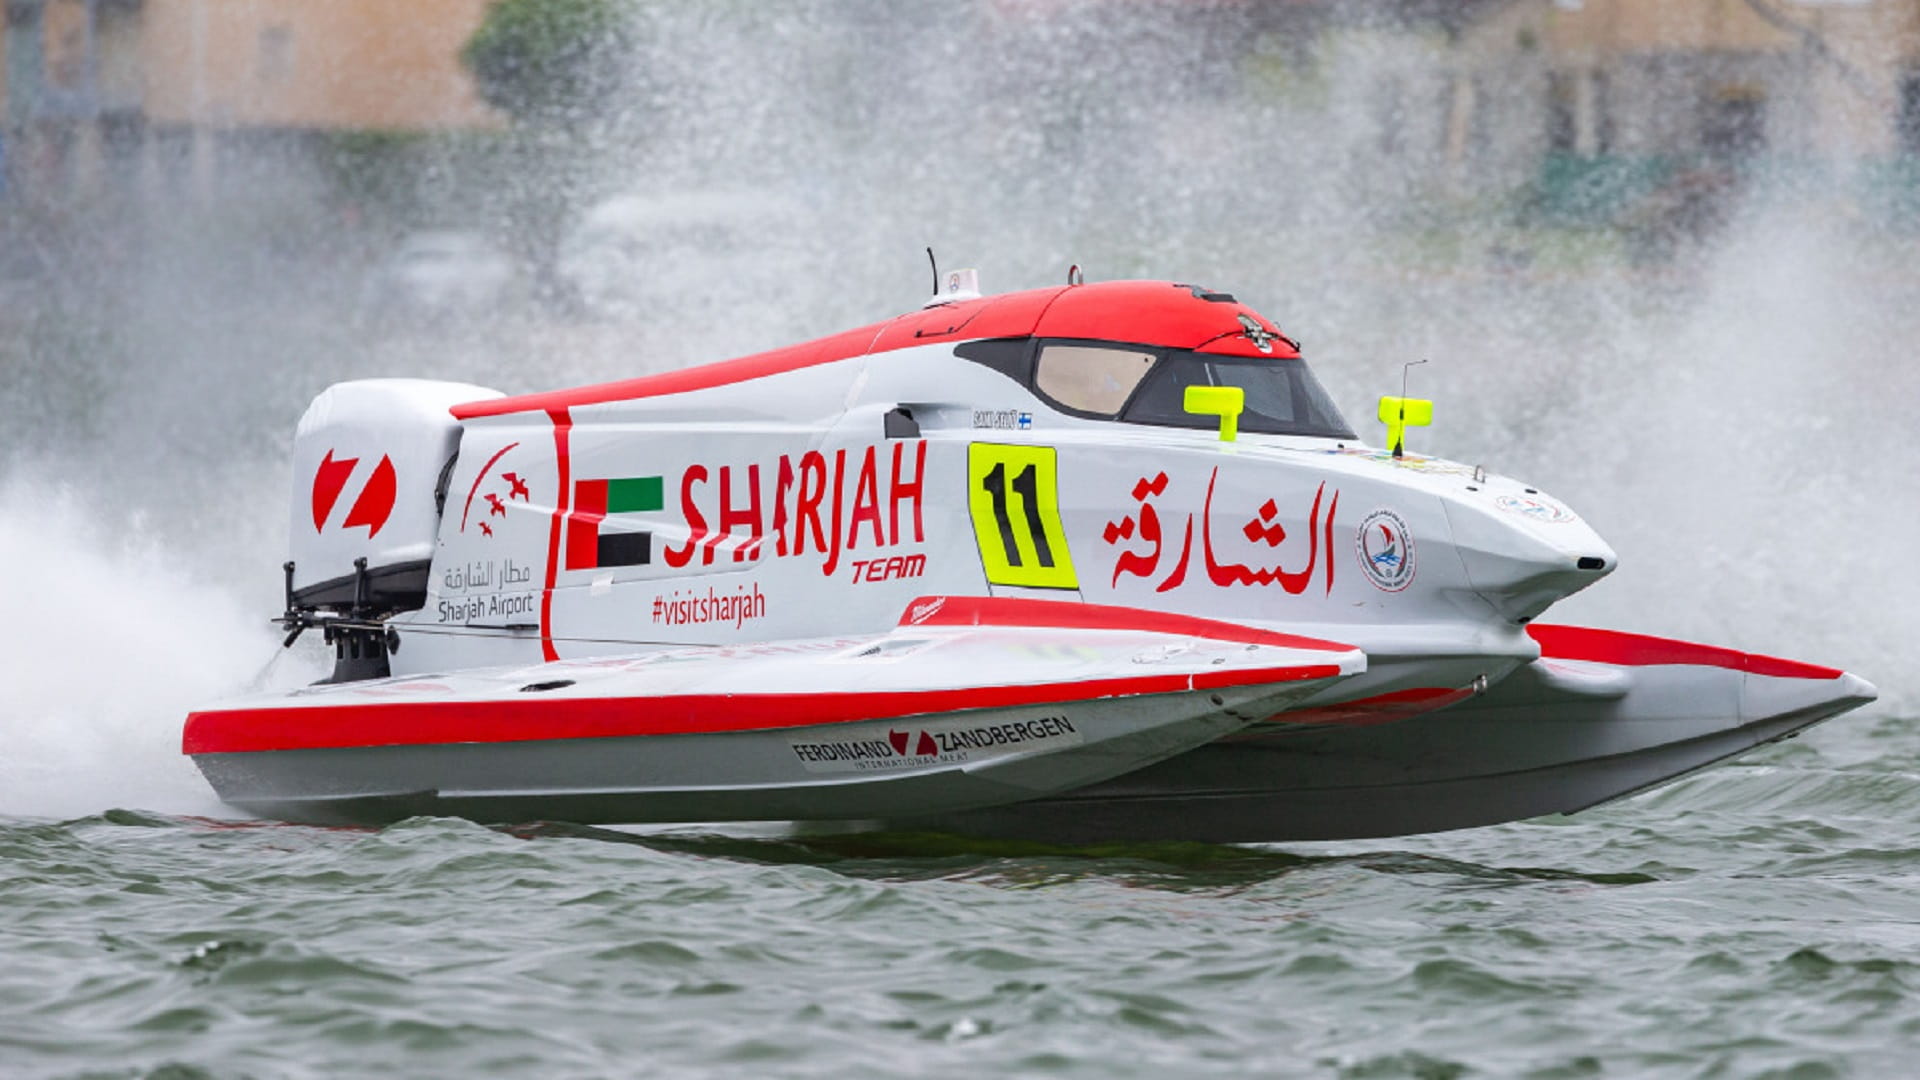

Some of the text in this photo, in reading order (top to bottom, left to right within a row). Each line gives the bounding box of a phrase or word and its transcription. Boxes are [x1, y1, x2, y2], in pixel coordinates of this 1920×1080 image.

[663, 439, 928, 577] SHARJAH
[982, 462, 1055, 568] 11
[1102, 465, 1340, 598] الشارقة
[444, 558, 530, 594] مطار الشارقة
[851, 553, 927, 585] TEAM
[438, 592, 534, 625] Sharjah Airport
[652, 582, 766, 630] #visitsharjah
[791, 715, 1076, 763] FERDINAND ZANDBERGEN
[854, 751, 969, 770] INTERNATIONAL MEAT
